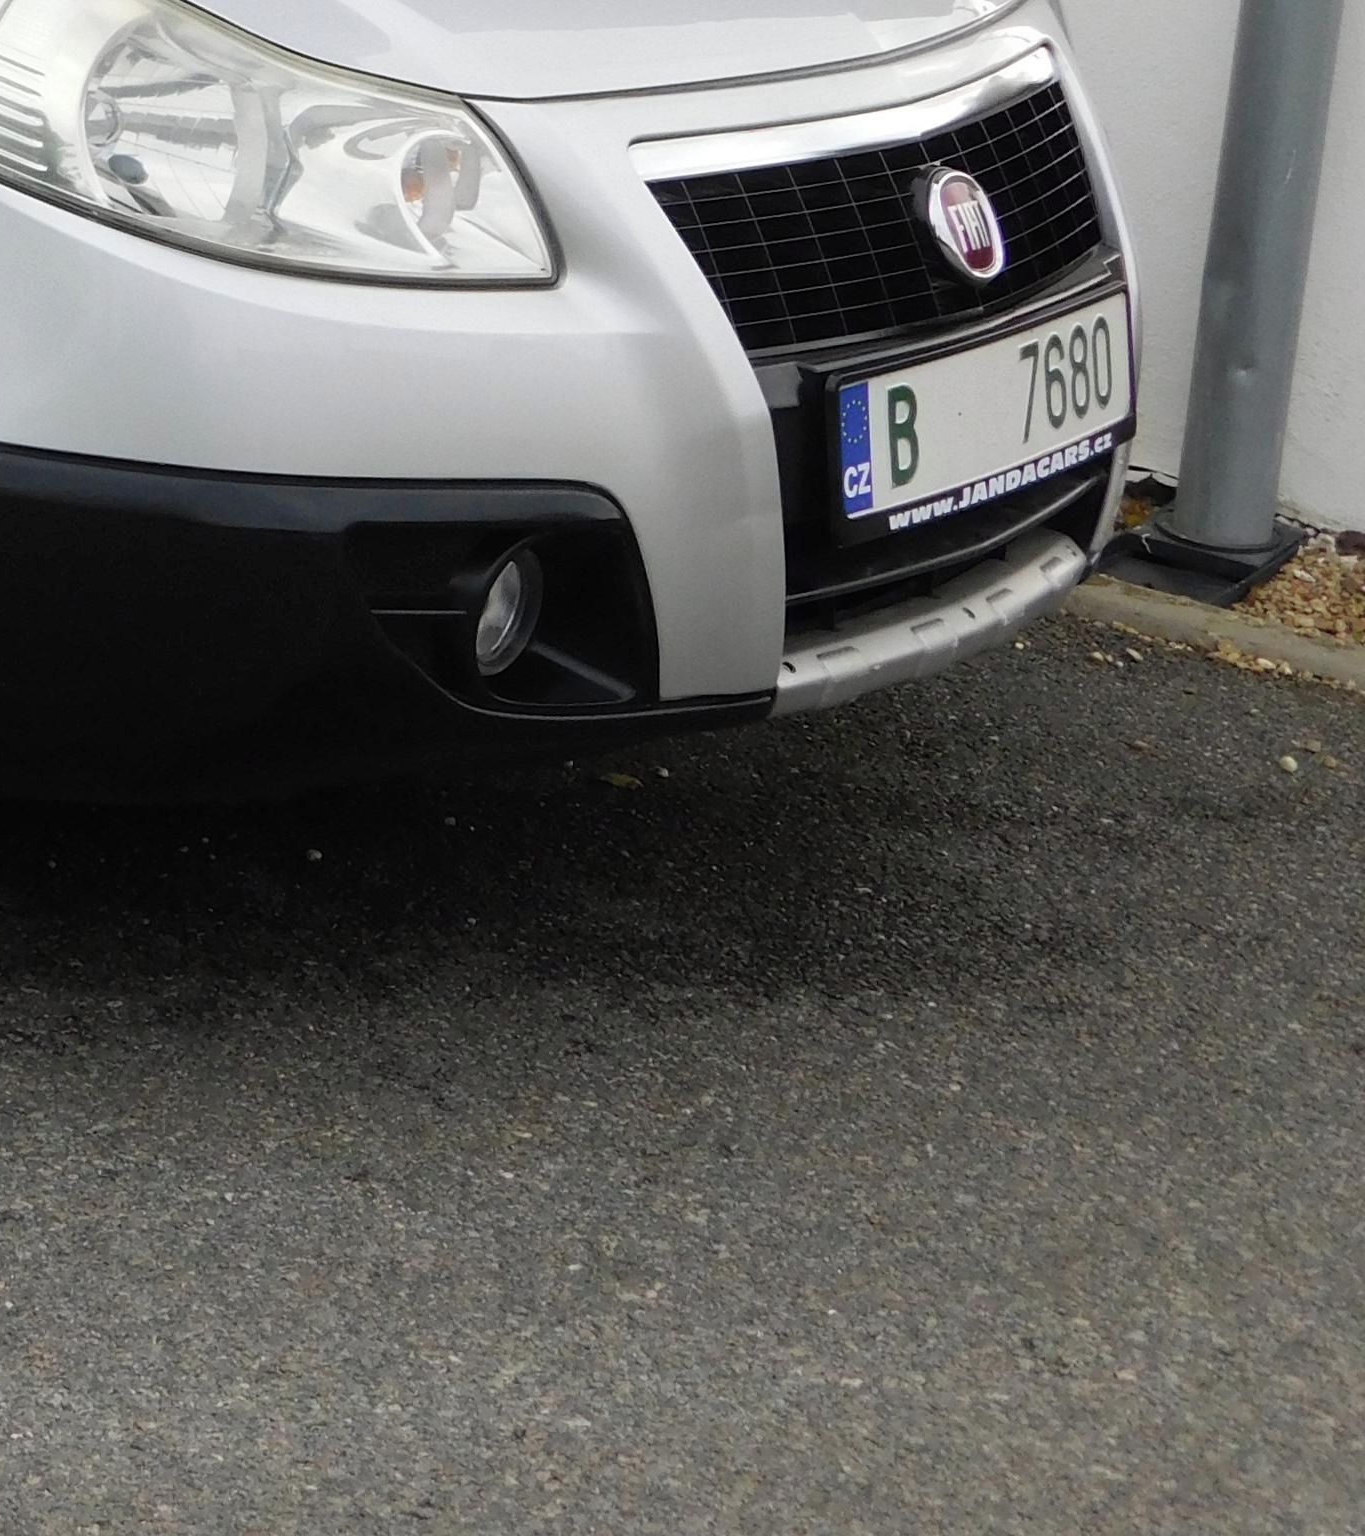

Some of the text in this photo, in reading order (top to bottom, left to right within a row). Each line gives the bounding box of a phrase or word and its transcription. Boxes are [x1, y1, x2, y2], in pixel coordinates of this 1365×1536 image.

[947, 200, 991, 253] FIAT
[887, 314, 1113, 489] B 7680
[843, 462, 871, 498] CZ
